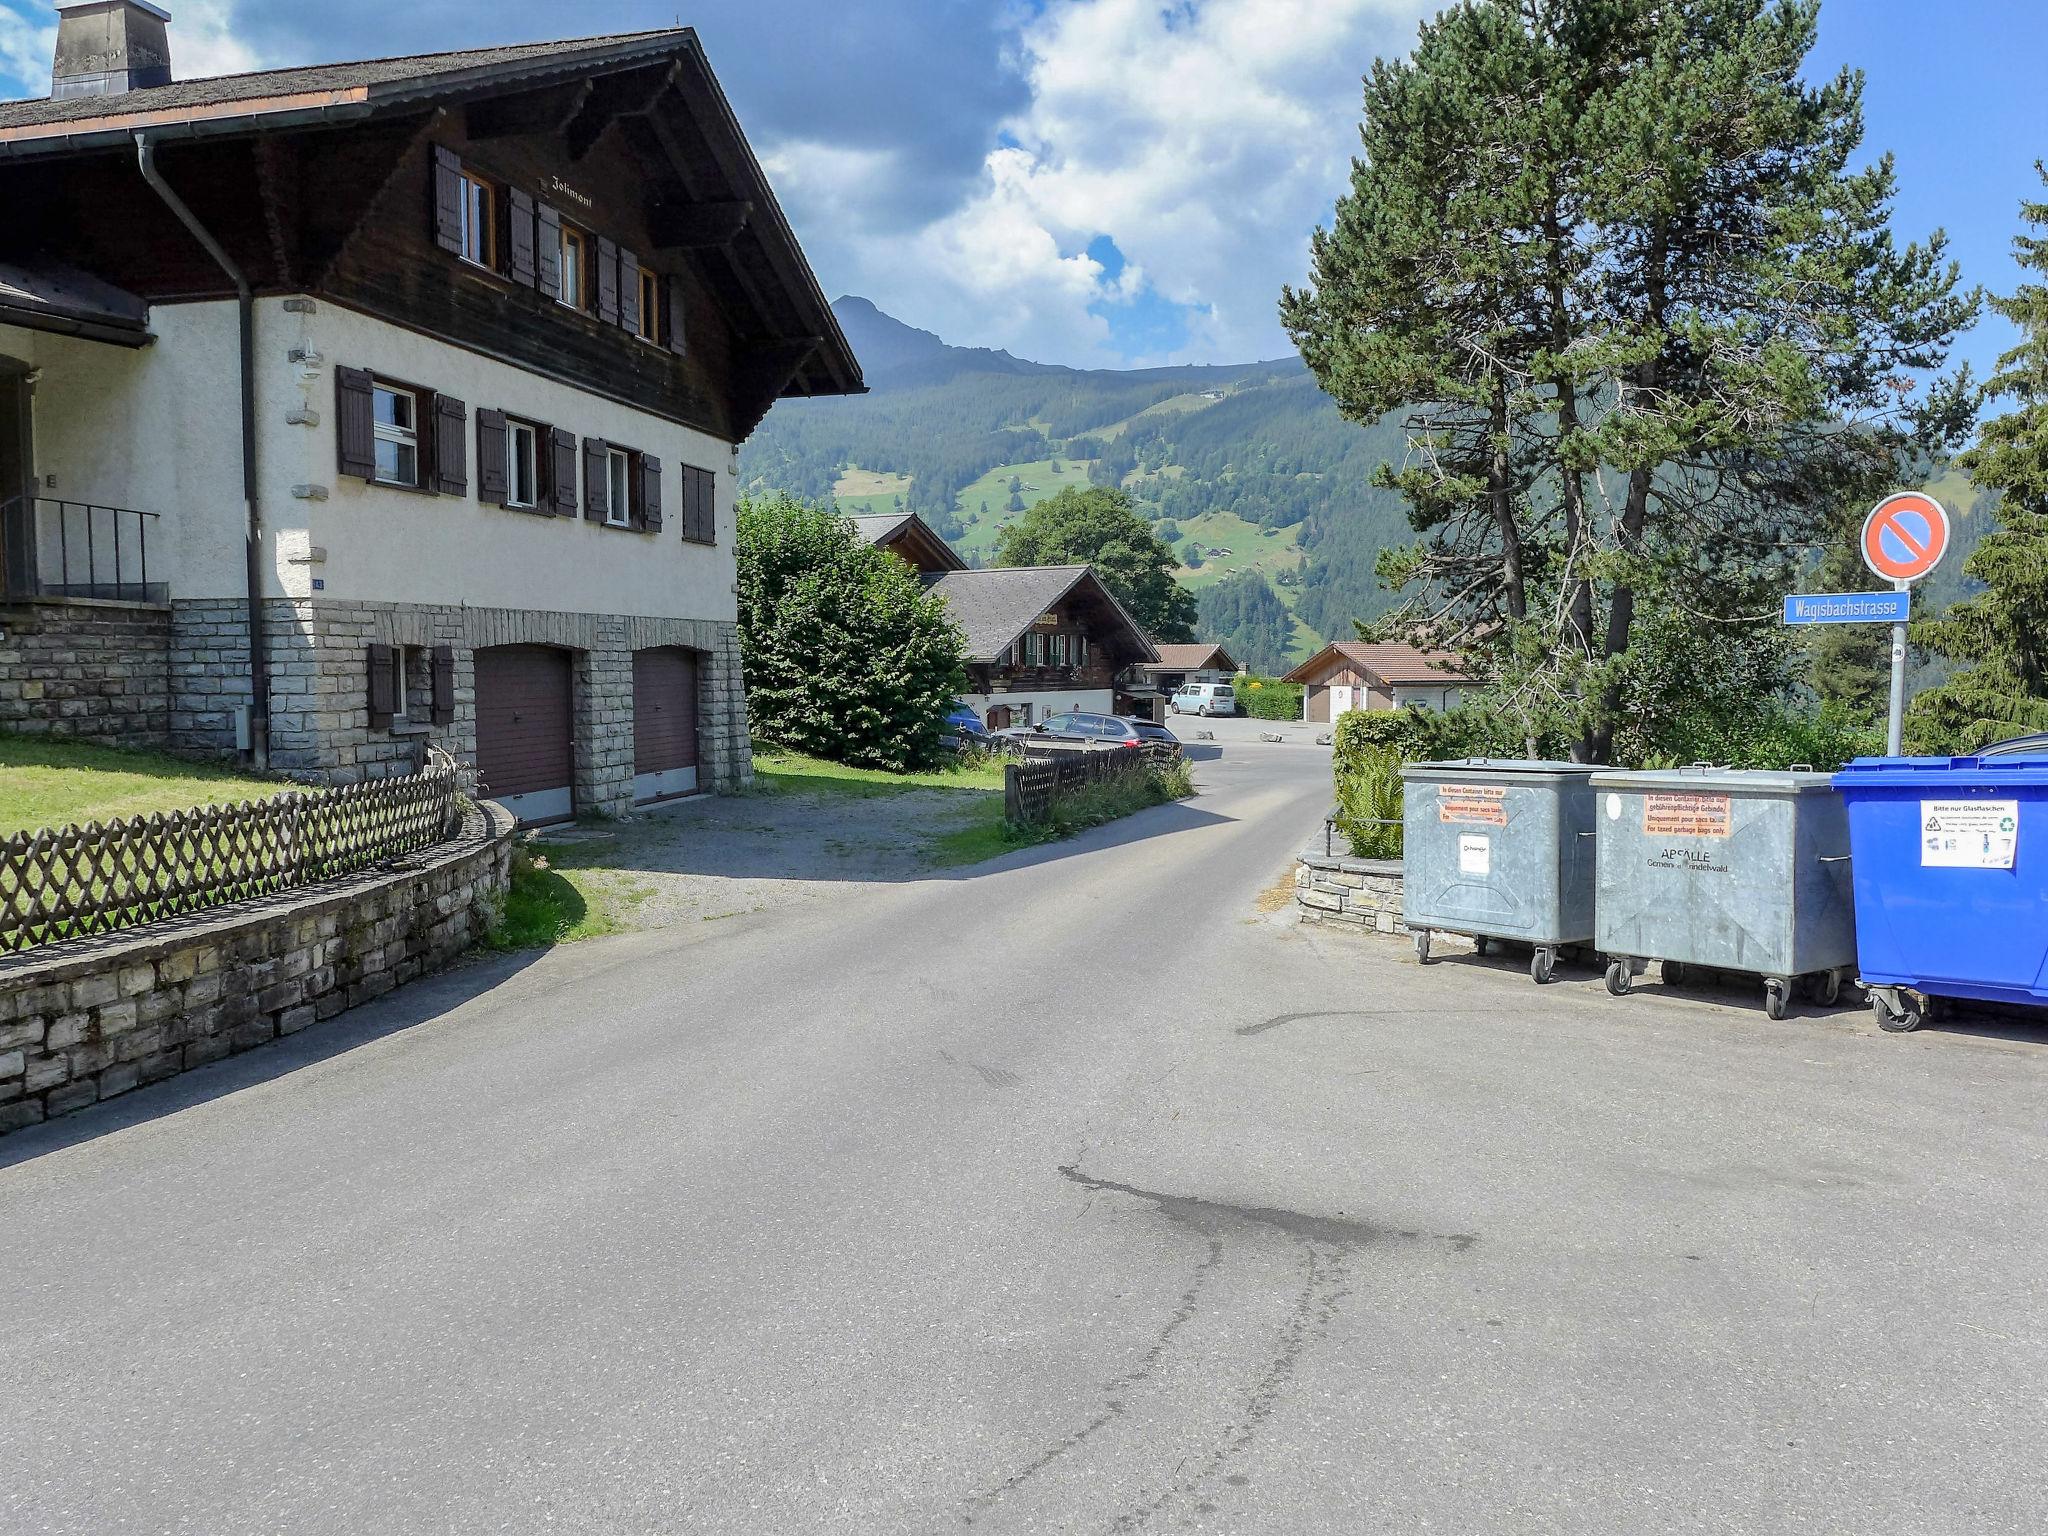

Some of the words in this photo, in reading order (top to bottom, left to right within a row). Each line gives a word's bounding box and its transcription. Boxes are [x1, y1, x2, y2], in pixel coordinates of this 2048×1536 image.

[552, 175, 592, 208] Jolimont
[1795, 598, 1897, 621] Wagisbachstrasse
[1647, 815, 1680, 823] Uniquement
[1674, 826, 1696, 834] garbage
[1697, 827, 1711, 835] bags
[1686, 864, 1728, 872] rindelwald
